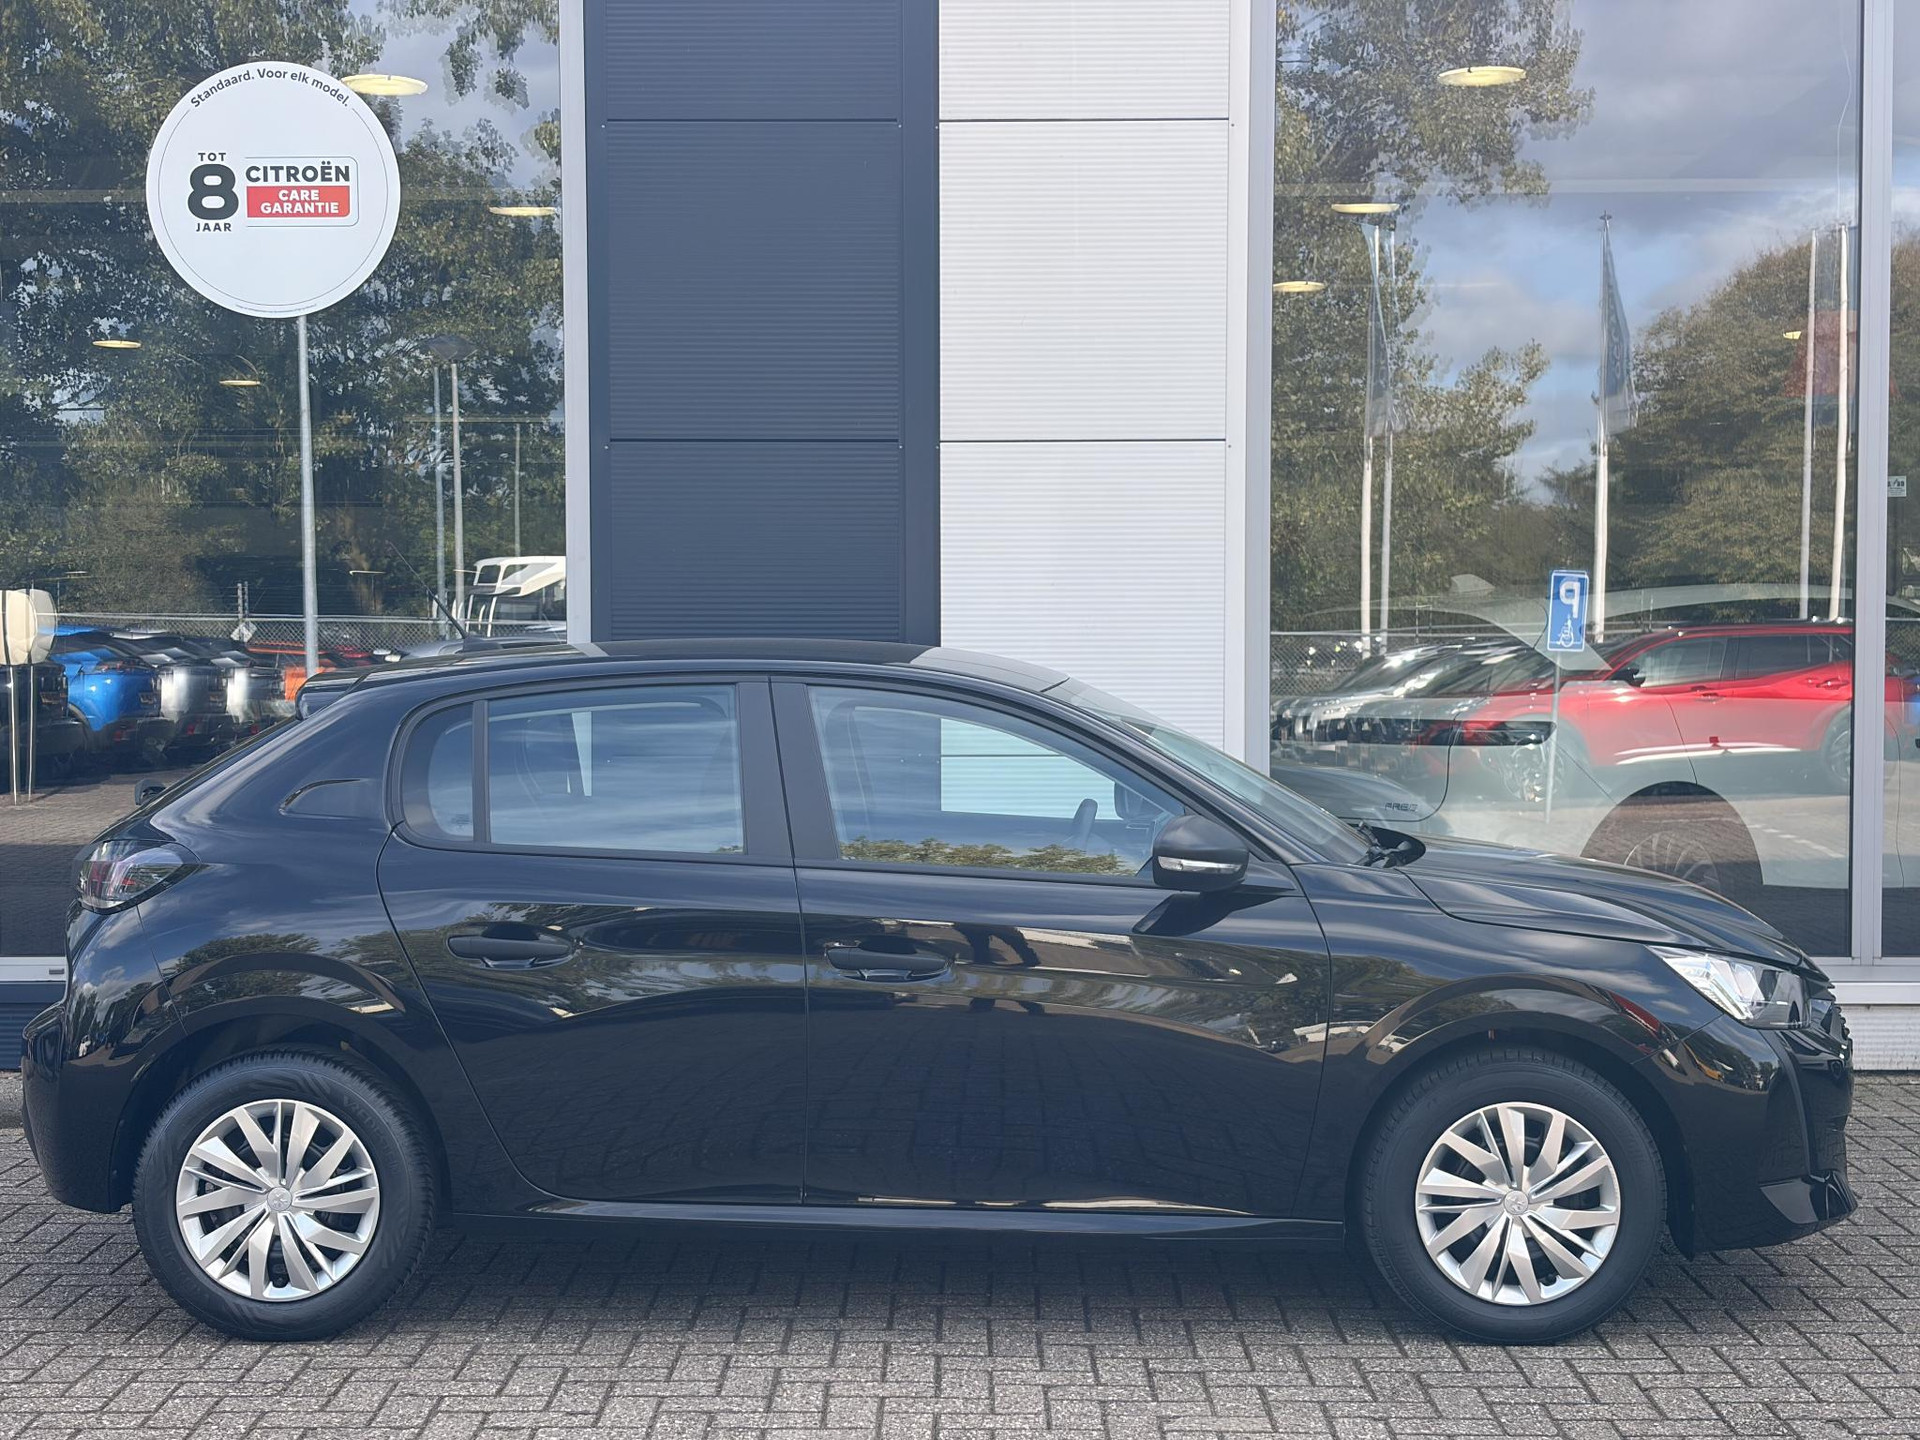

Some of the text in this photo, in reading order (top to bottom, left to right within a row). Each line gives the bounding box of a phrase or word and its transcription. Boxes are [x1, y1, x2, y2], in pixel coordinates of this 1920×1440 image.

[191, 68, 349, 108] Standaard. Voor elk model.
[198, 152, 226, 162] TOT
[245, 160, 350, 183] CITROËN
[187, 163, 239, 220] 8
[278, 189, 320, 201] CARE
[260, 202, 339, 214] GARANTIE
[196, 222, 232, 232] JAAR
